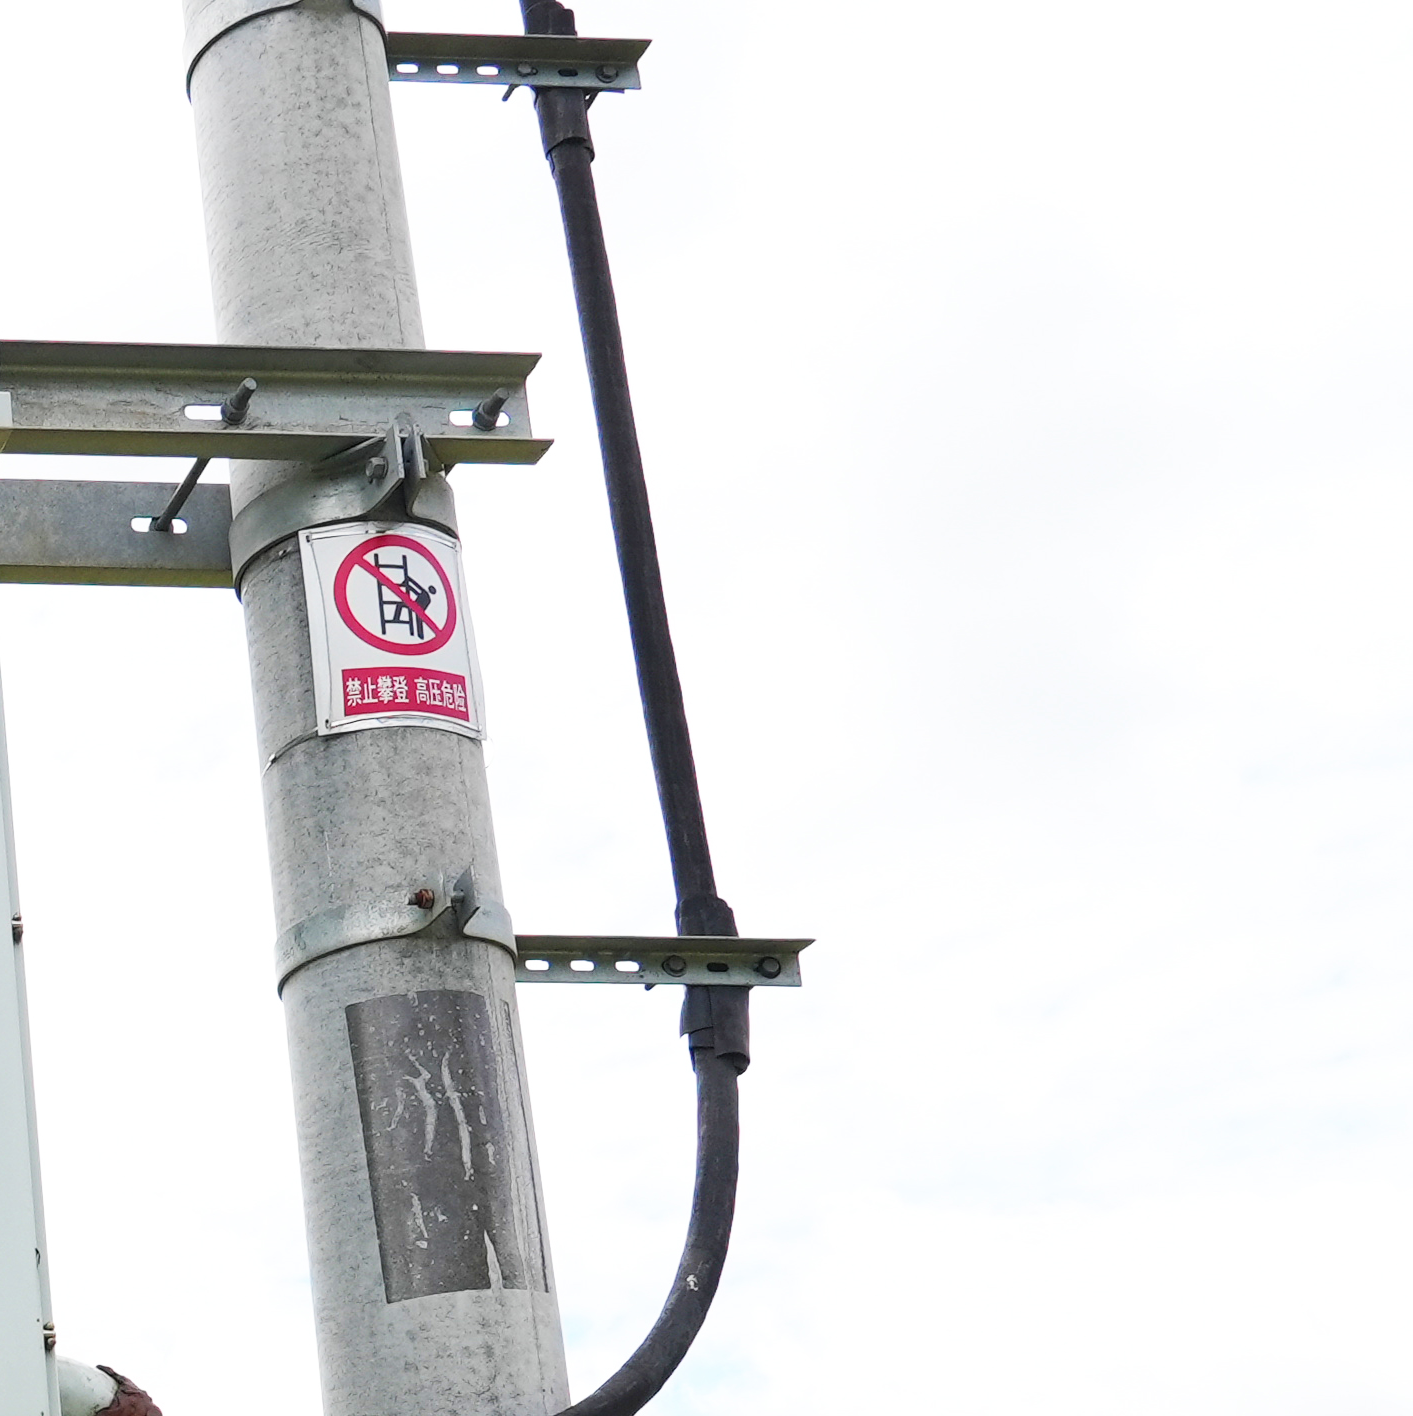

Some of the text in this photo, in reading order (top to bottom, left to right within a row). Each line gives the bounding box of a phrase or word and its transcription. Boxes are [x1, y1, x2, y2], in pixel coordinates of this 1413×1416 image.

[346, 675, 467, 712] 禁止攀登 高压危险
